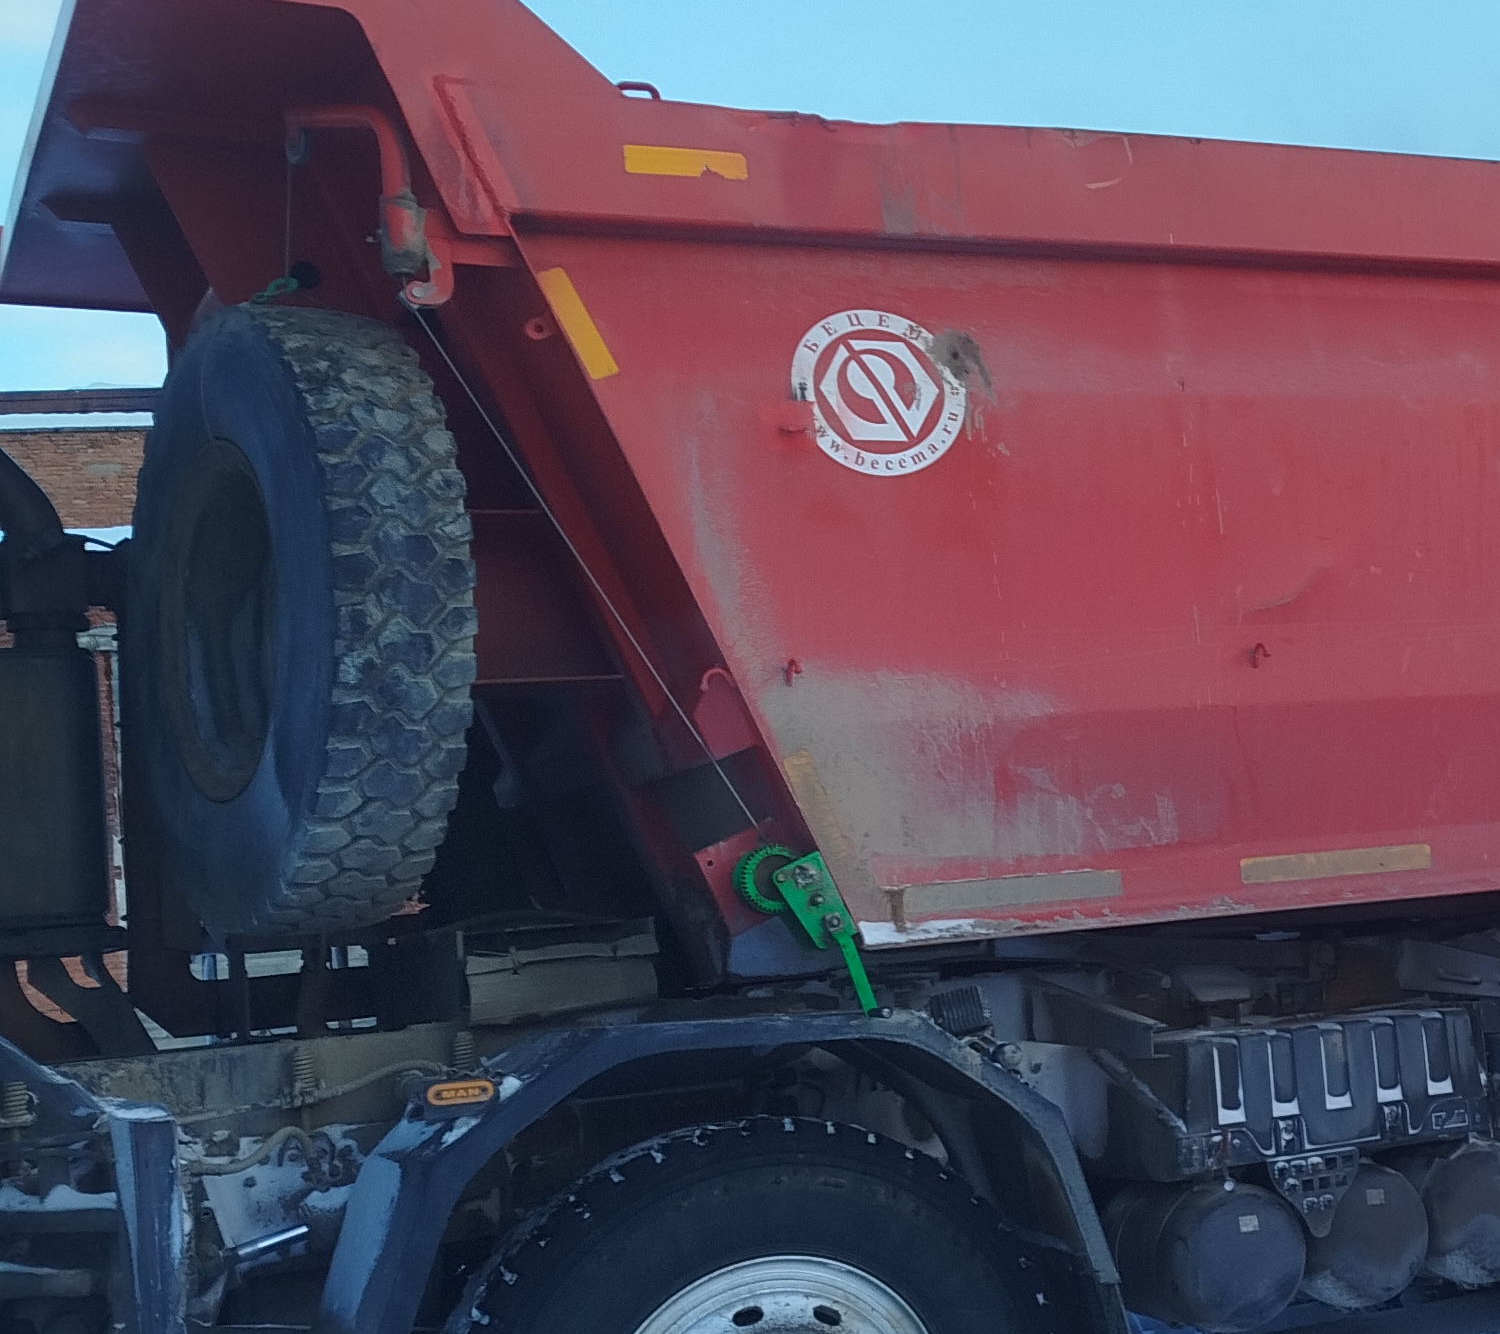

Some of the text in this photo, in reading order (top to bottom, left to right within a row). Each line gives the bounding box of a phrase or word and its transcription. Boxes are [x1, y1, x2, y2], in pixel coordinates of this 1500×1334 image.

[803, 312, 924, 354] БЕЦЕМ
[813, 411, 959, 471] ww.becema.ru
[441, 1087, 481, 1099] MAN
